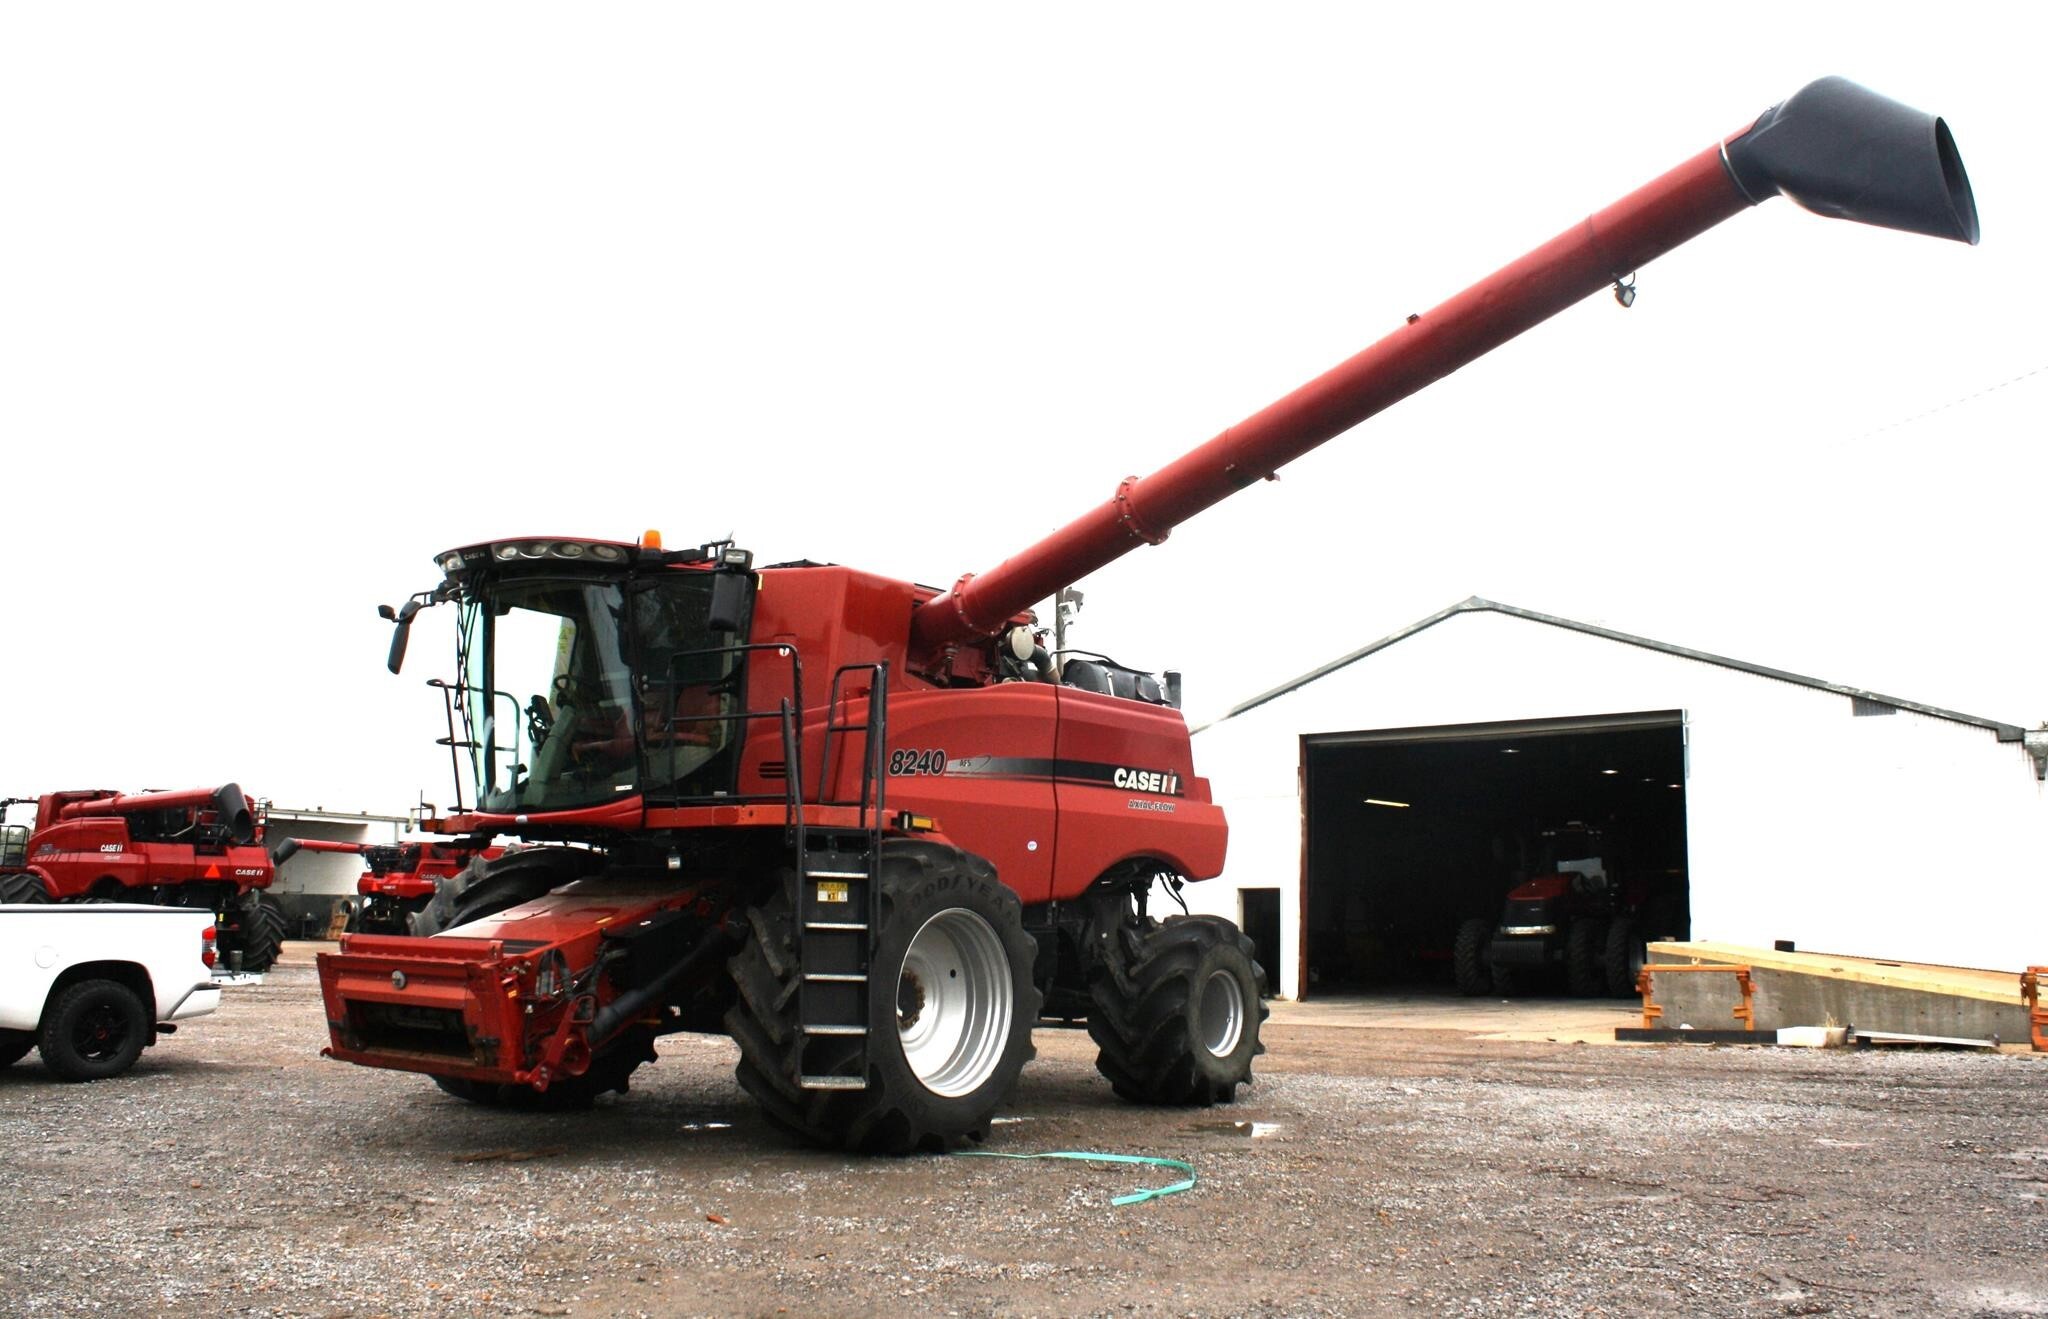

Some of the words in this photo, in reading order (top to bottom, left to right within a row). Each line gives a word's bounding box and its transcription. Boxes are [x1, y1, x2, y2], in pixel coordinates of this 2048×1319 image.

[888, 749, 946, 776] 8240
[1114, 767, 1161, 792] CASE
[100, 844, 117, 852] CASE
[235, 868, 256, 876] CASE
